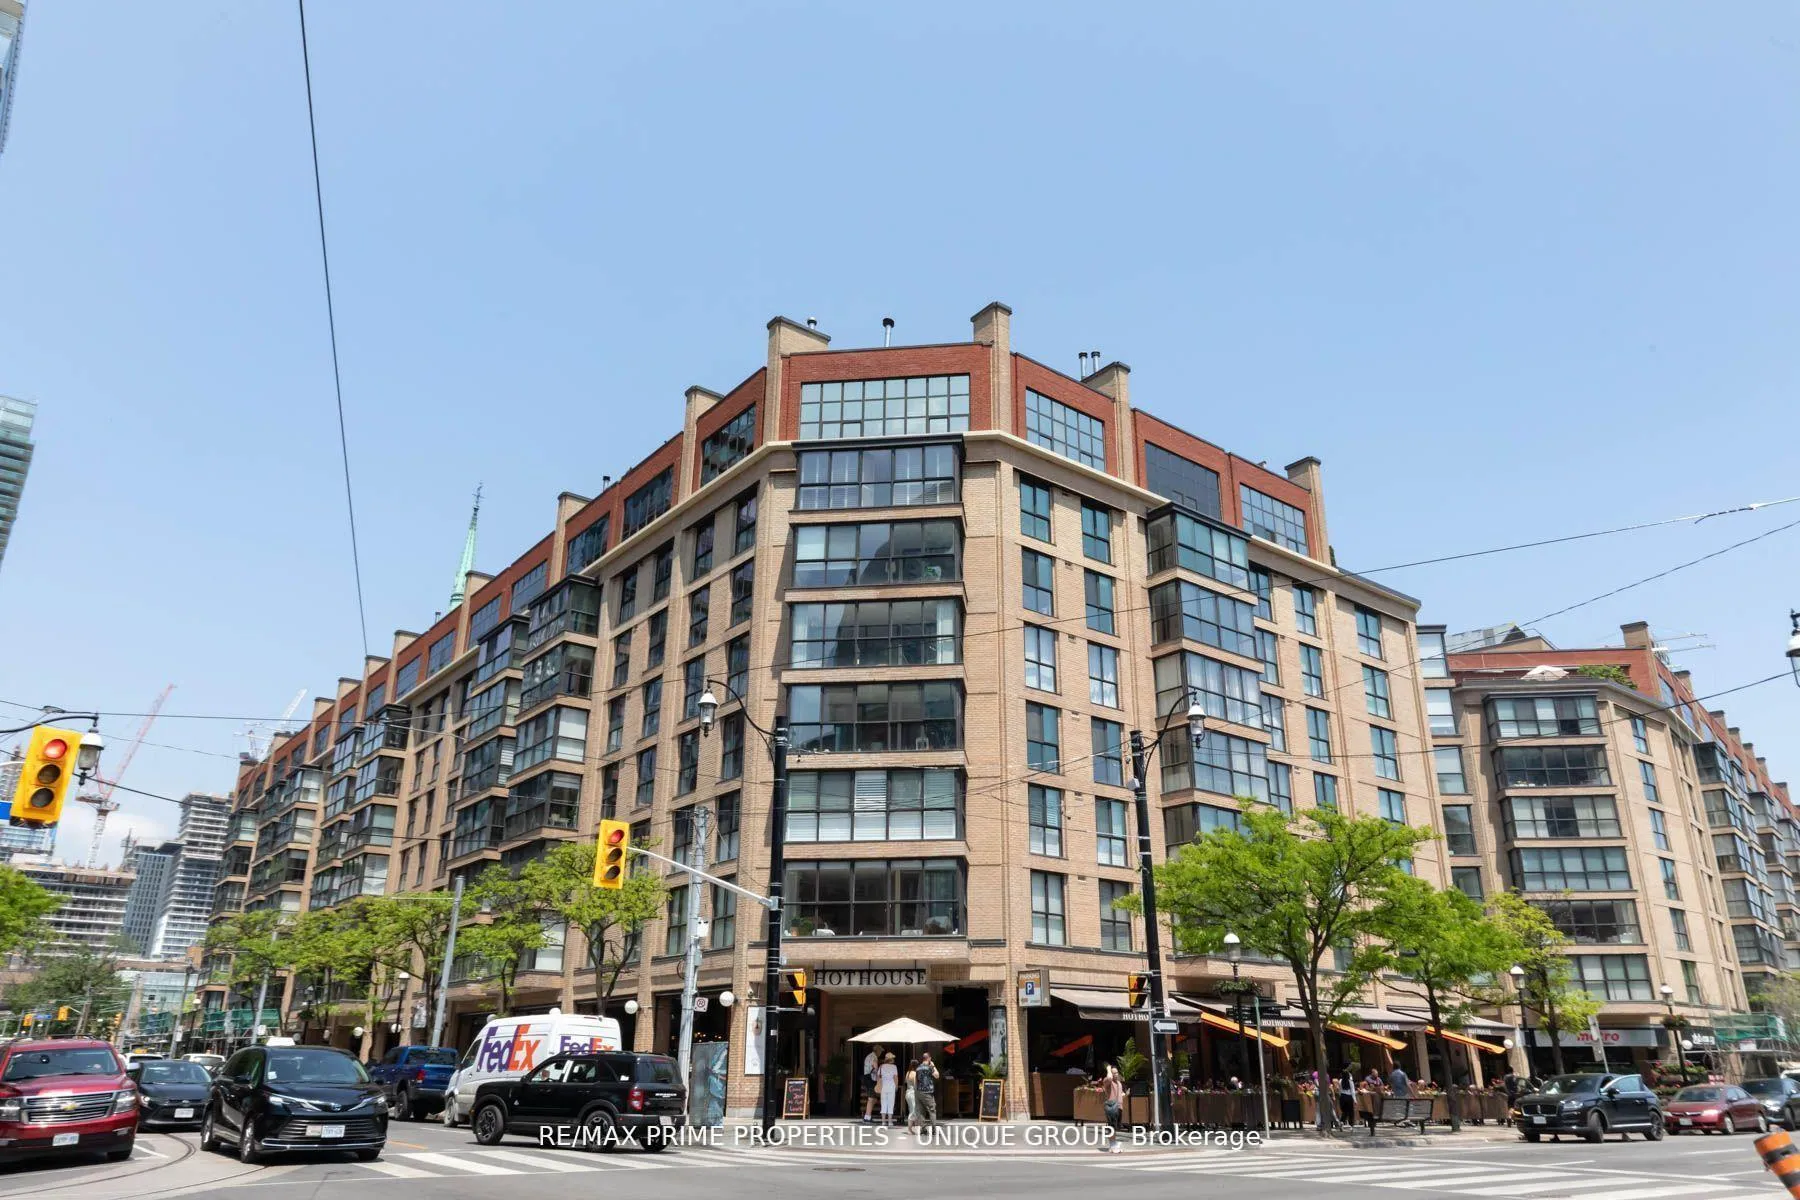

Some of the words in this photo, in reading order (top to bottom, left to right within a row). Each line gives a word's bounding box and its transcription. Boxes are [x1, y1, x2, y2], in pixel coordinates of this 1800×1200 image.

[813, 969, 927, 985] HOTHOUSE
[1122, 1012, 1149, 1020] HOTHO
[1261, 1019, 1295, 1027] HOTHOUSE
[476, 1023, 541, 1073] FedEx
